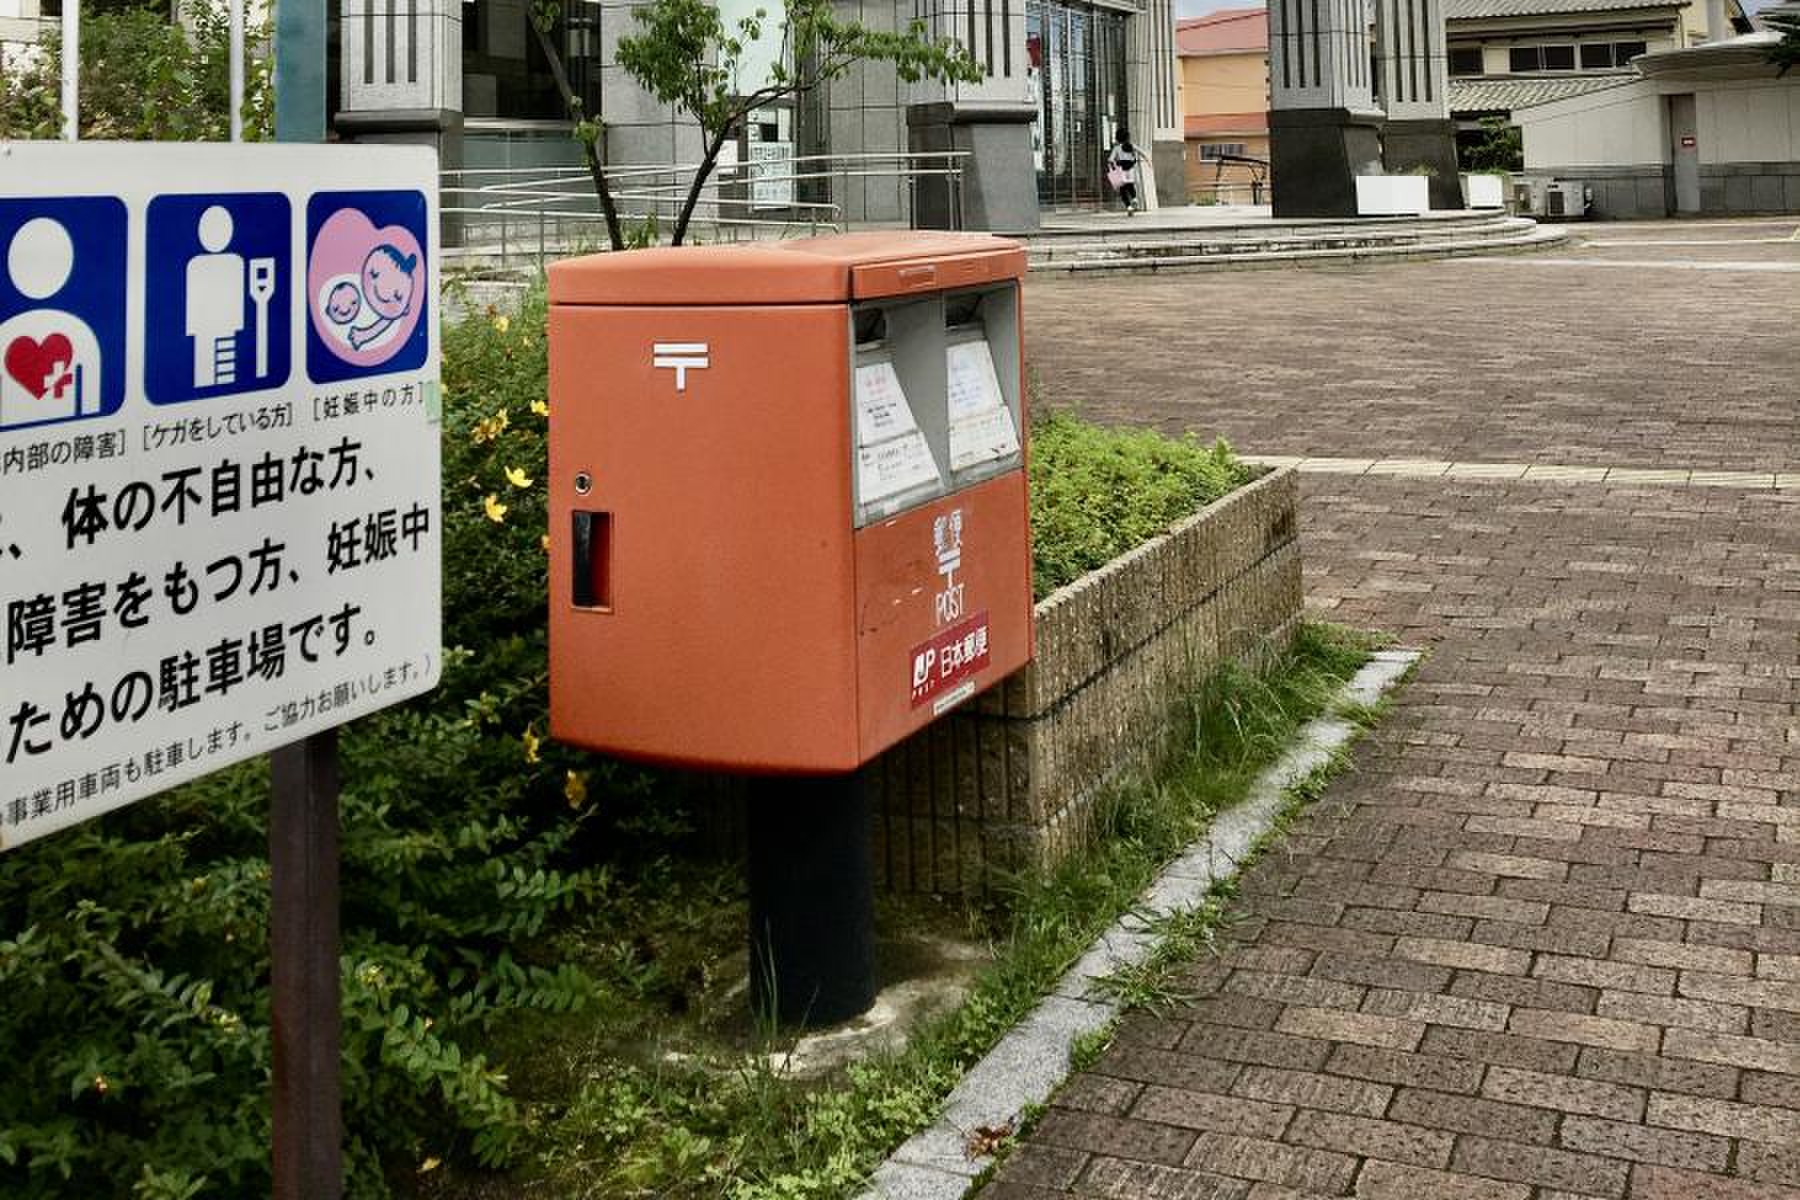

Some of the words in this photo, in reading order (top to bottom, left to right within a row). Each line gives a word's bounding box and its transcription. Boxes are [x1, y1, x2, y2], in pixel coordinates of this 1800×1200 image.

[0, 428, 126, 476] 内部の障害]
[143, 402, 293, 451] [ケガをしている方]
[313, 381, 423, 422] [妊娠中の方]
[935, 582, 964, 626] POST
[6, 602, 376, 764] ための駐車場です。
